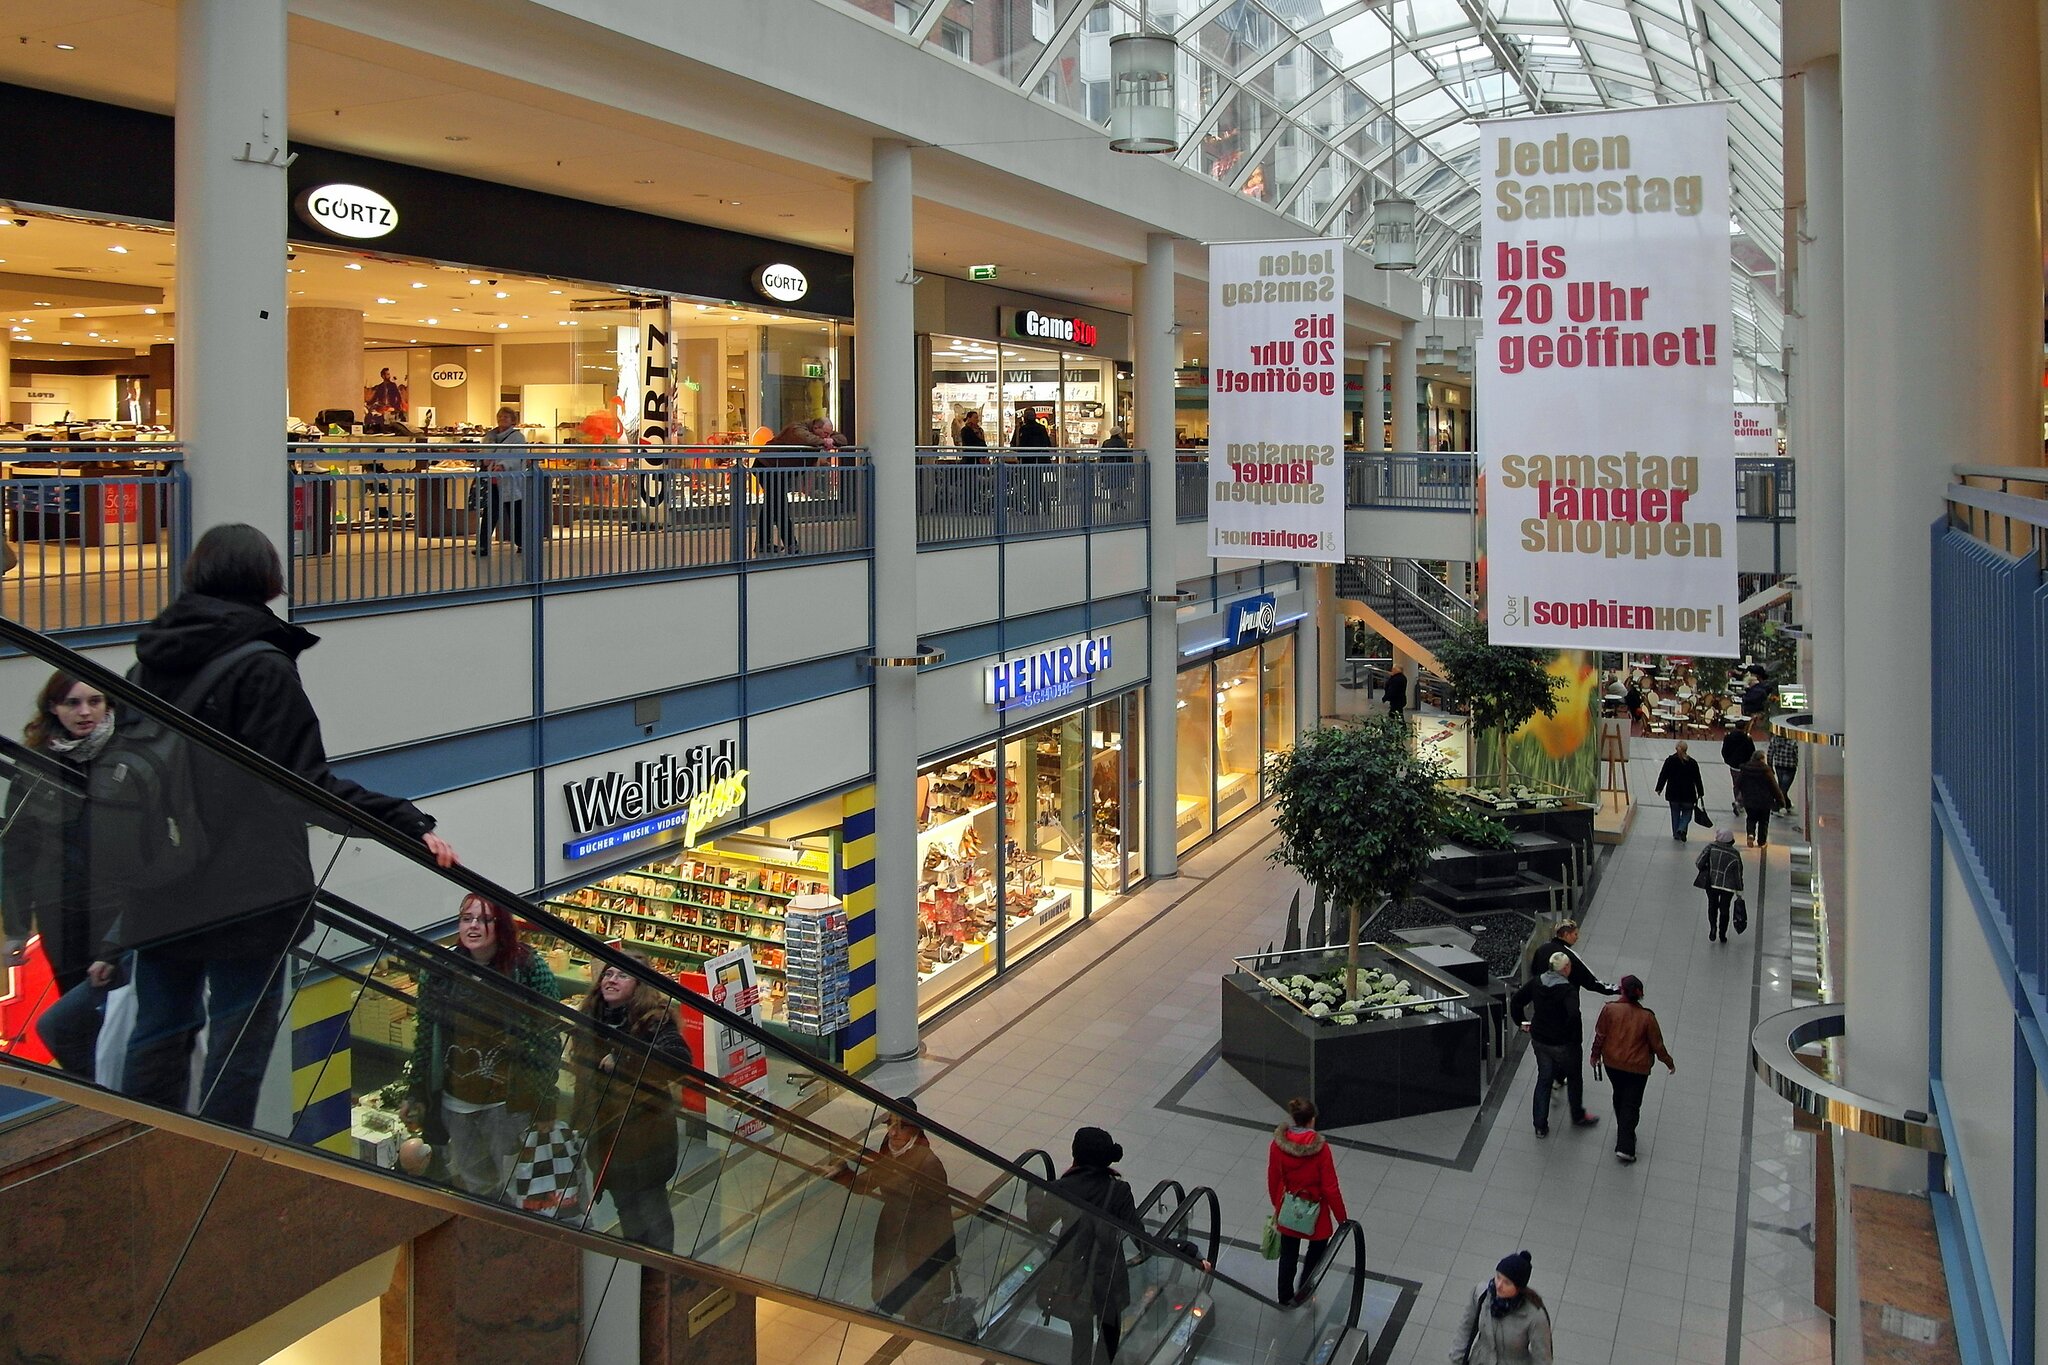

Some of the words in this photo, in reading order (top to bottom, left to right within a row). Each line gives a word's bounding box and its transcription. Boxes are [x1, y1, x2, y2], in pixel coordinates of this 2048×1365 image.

[1495, 132, 1631, 178] Jeden
[1495, 174, 1704, 222] Samstag
[1497, 239, 1567, 281] bis
[1497, 283, 1553, 325] 20
[1567, 281, 1649, 323] Uhr
[1026, 310, 1097, 347] GameStop
[1498, 324, 1717, 375] geöffnet!
[966, 371, 988, 383] Wii
[1008, 371, 1032, 382] Wii
[1501, 451, 1699, 496] samstag
[1538, 478, 1689, 526] länger
[1520, 511, 1722, 560] shoppen
[1503, 594, 1521, 627] Quer
[990, 635, 1112, 704] HEINRICH
[563, 738, 736, 834] Weltbild
[579, 837, 615, 857] BÜCHER
[622, 825, 650, 842] MUSIK
